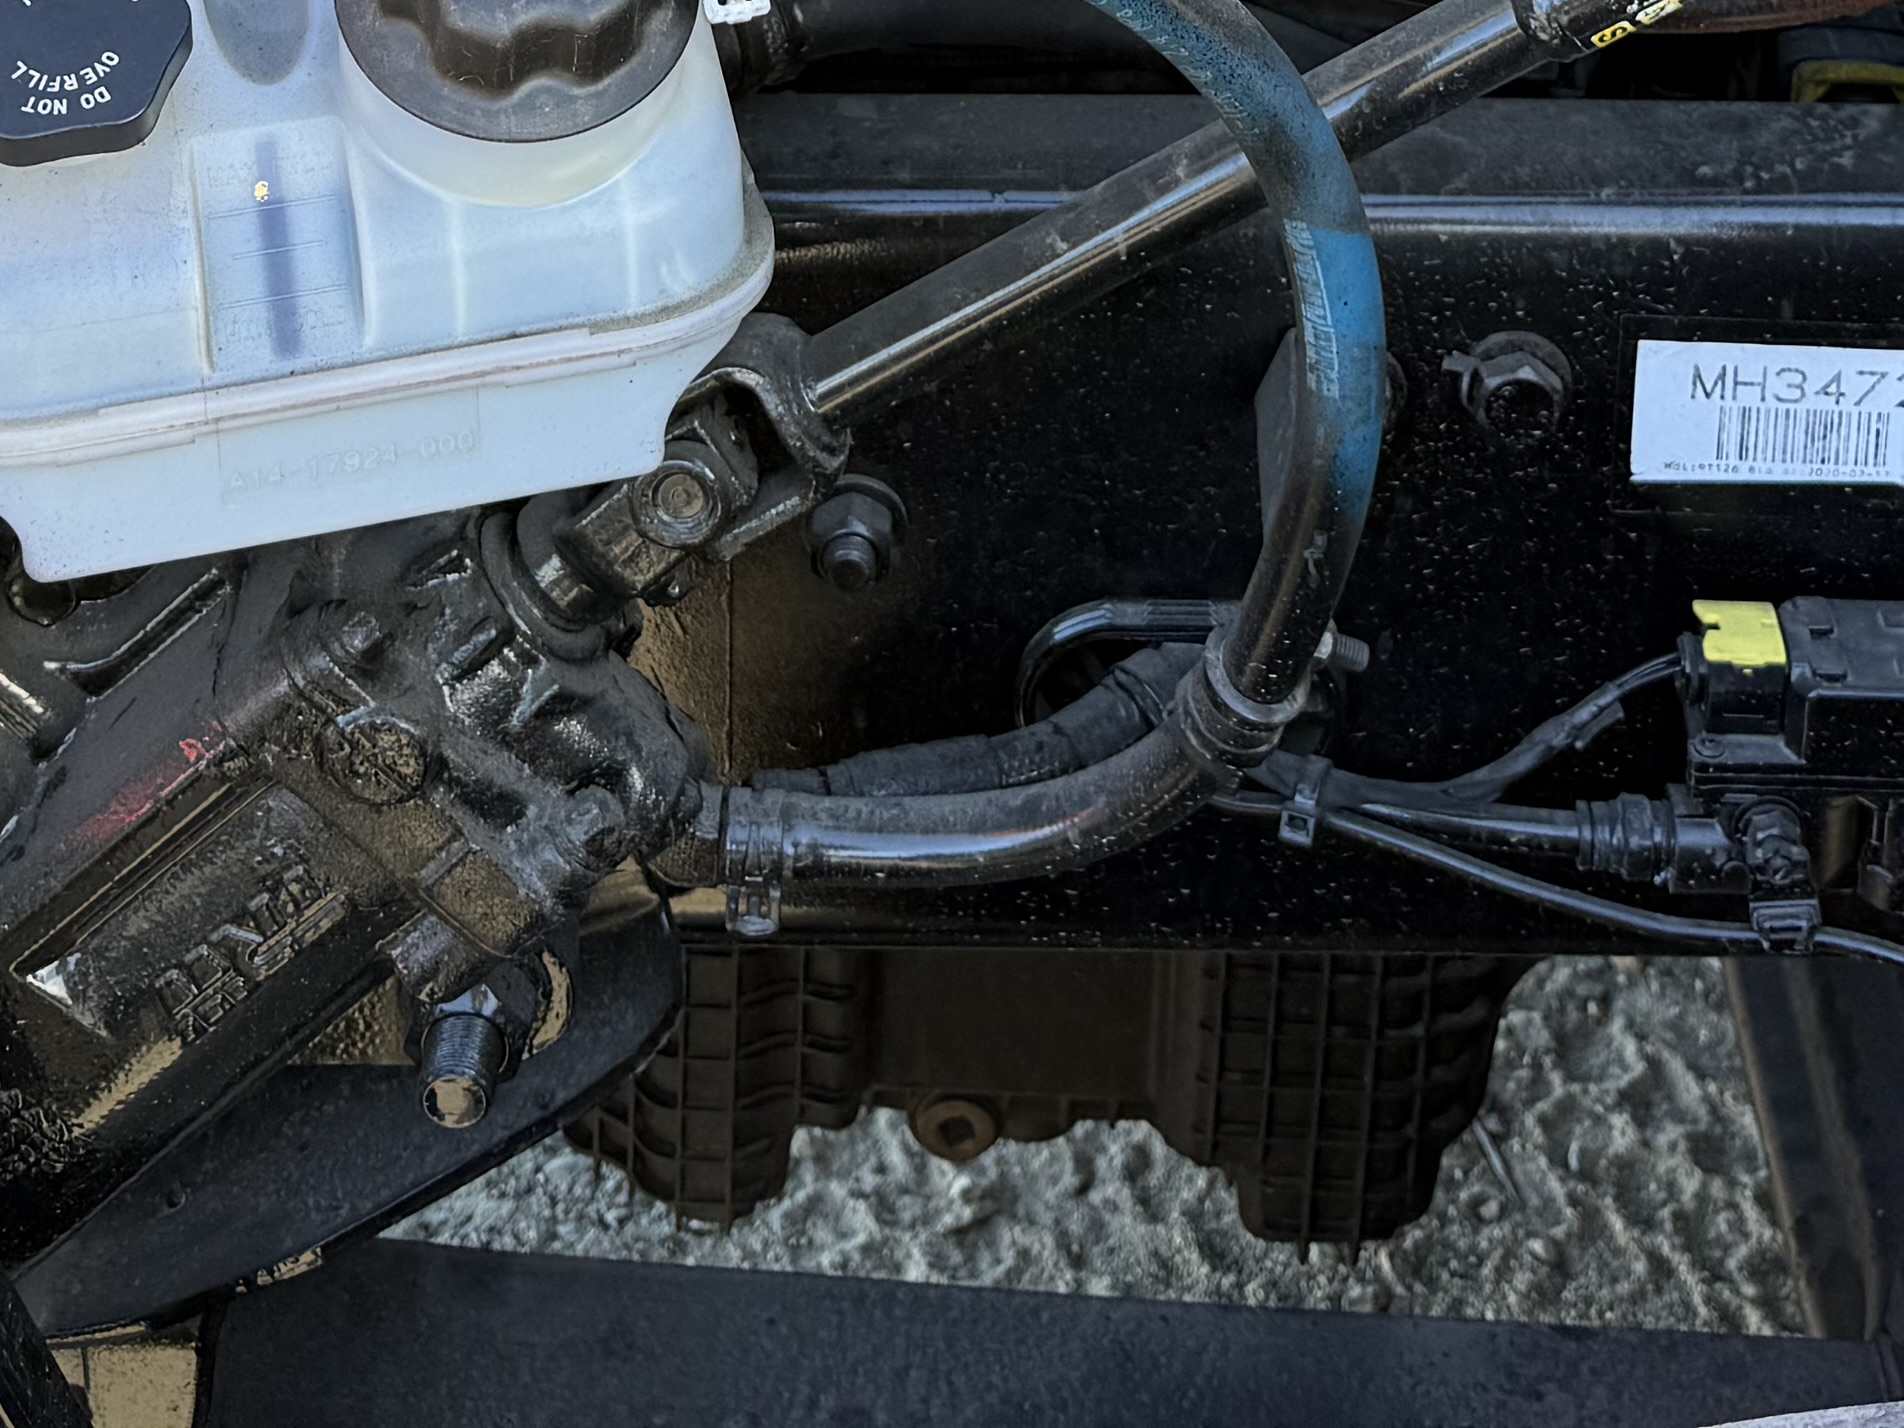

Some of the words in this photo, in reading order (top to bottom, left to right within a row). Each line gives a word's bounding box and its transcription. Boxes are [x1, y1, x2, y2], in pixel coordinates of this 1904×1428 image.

[10, 51, 121, 93] OVERFILL
[20, 95, 69, 116] NOT
[79, 85, 112, 110] DO
